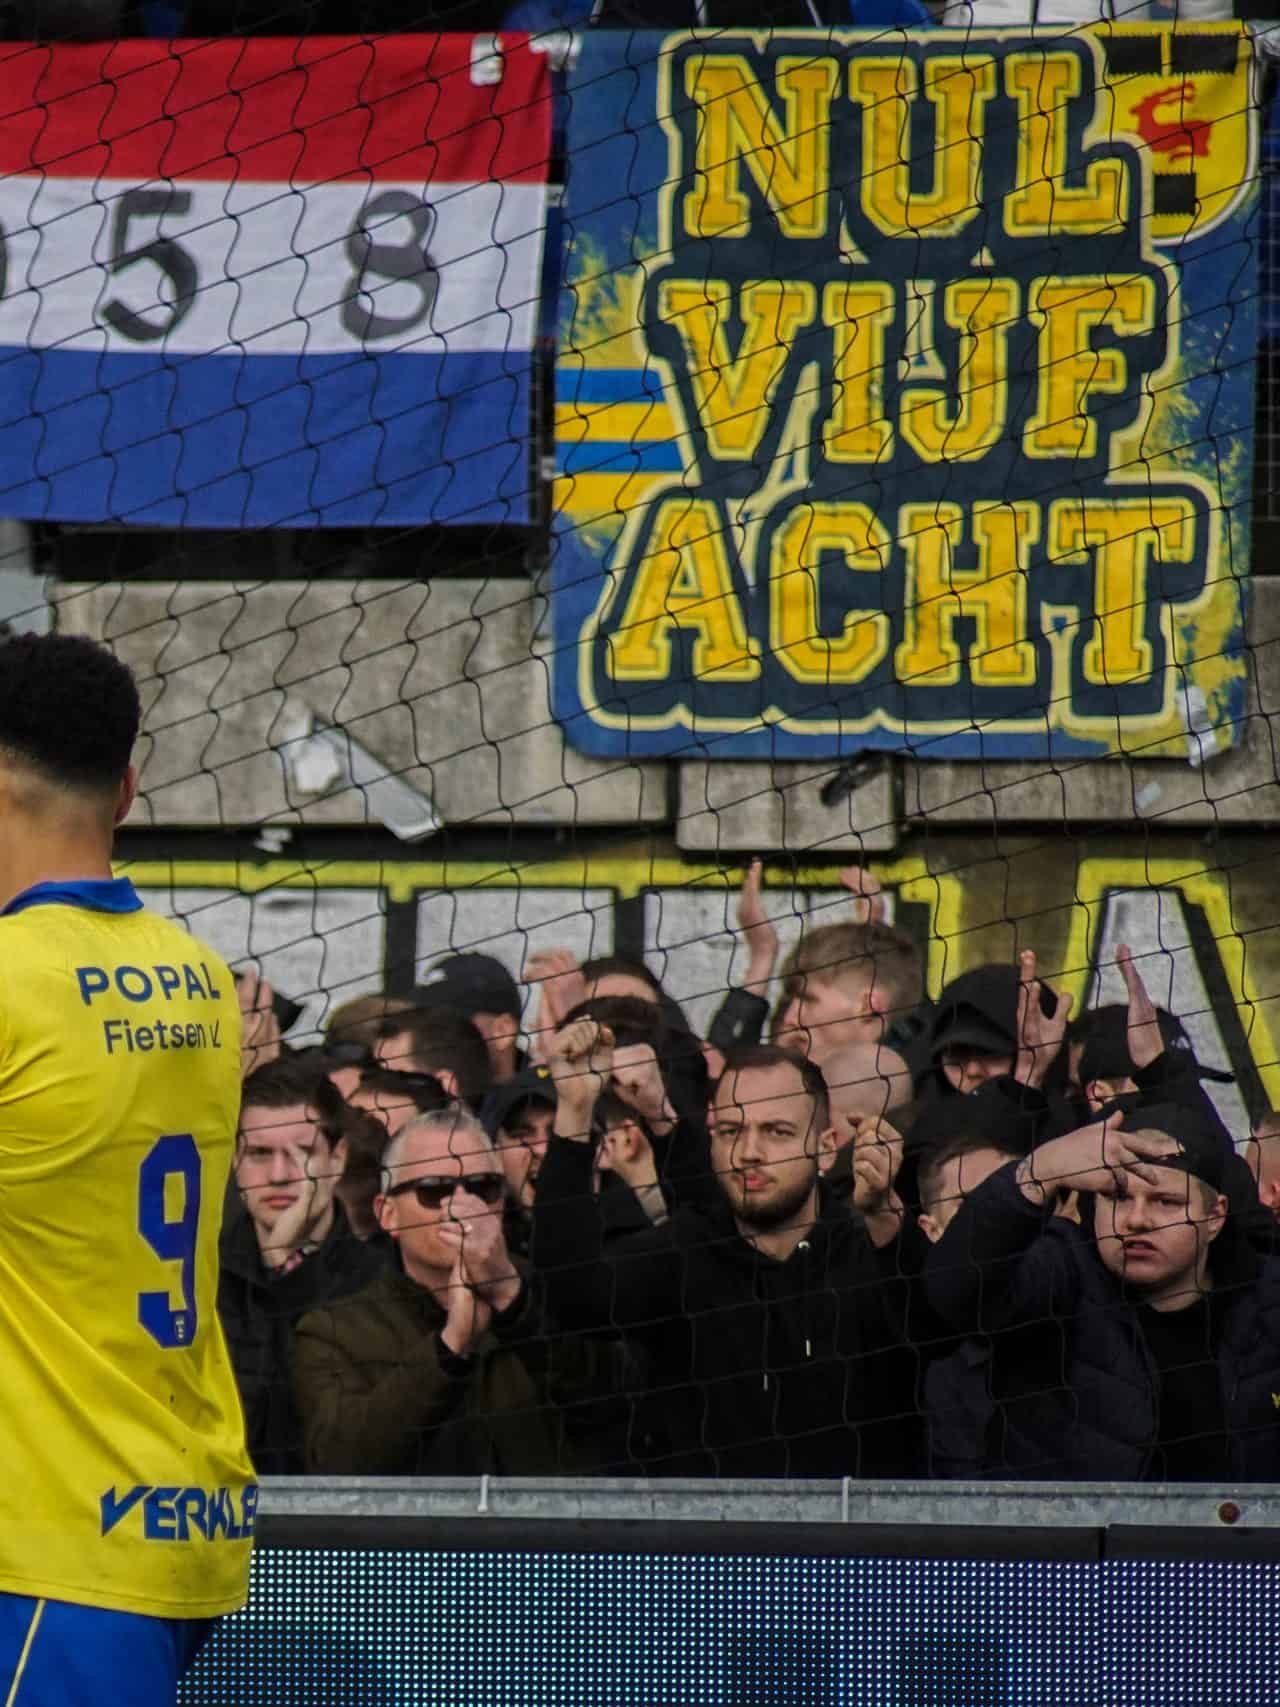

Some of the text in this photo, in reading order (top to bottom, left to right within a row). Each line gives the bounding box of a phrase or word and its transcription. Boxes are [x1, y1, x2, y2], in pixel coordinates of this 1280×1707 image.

[683, 53, 1130, 238] NUL
[658, 275, 1156, 464] VIJF
[606, 498, 1195, 687] ACHT
[76, 962, 221, 1006] POPAL
[103, 1018, 207, 1054] Fietsen
[137, 1133, 201, 1349] 9
